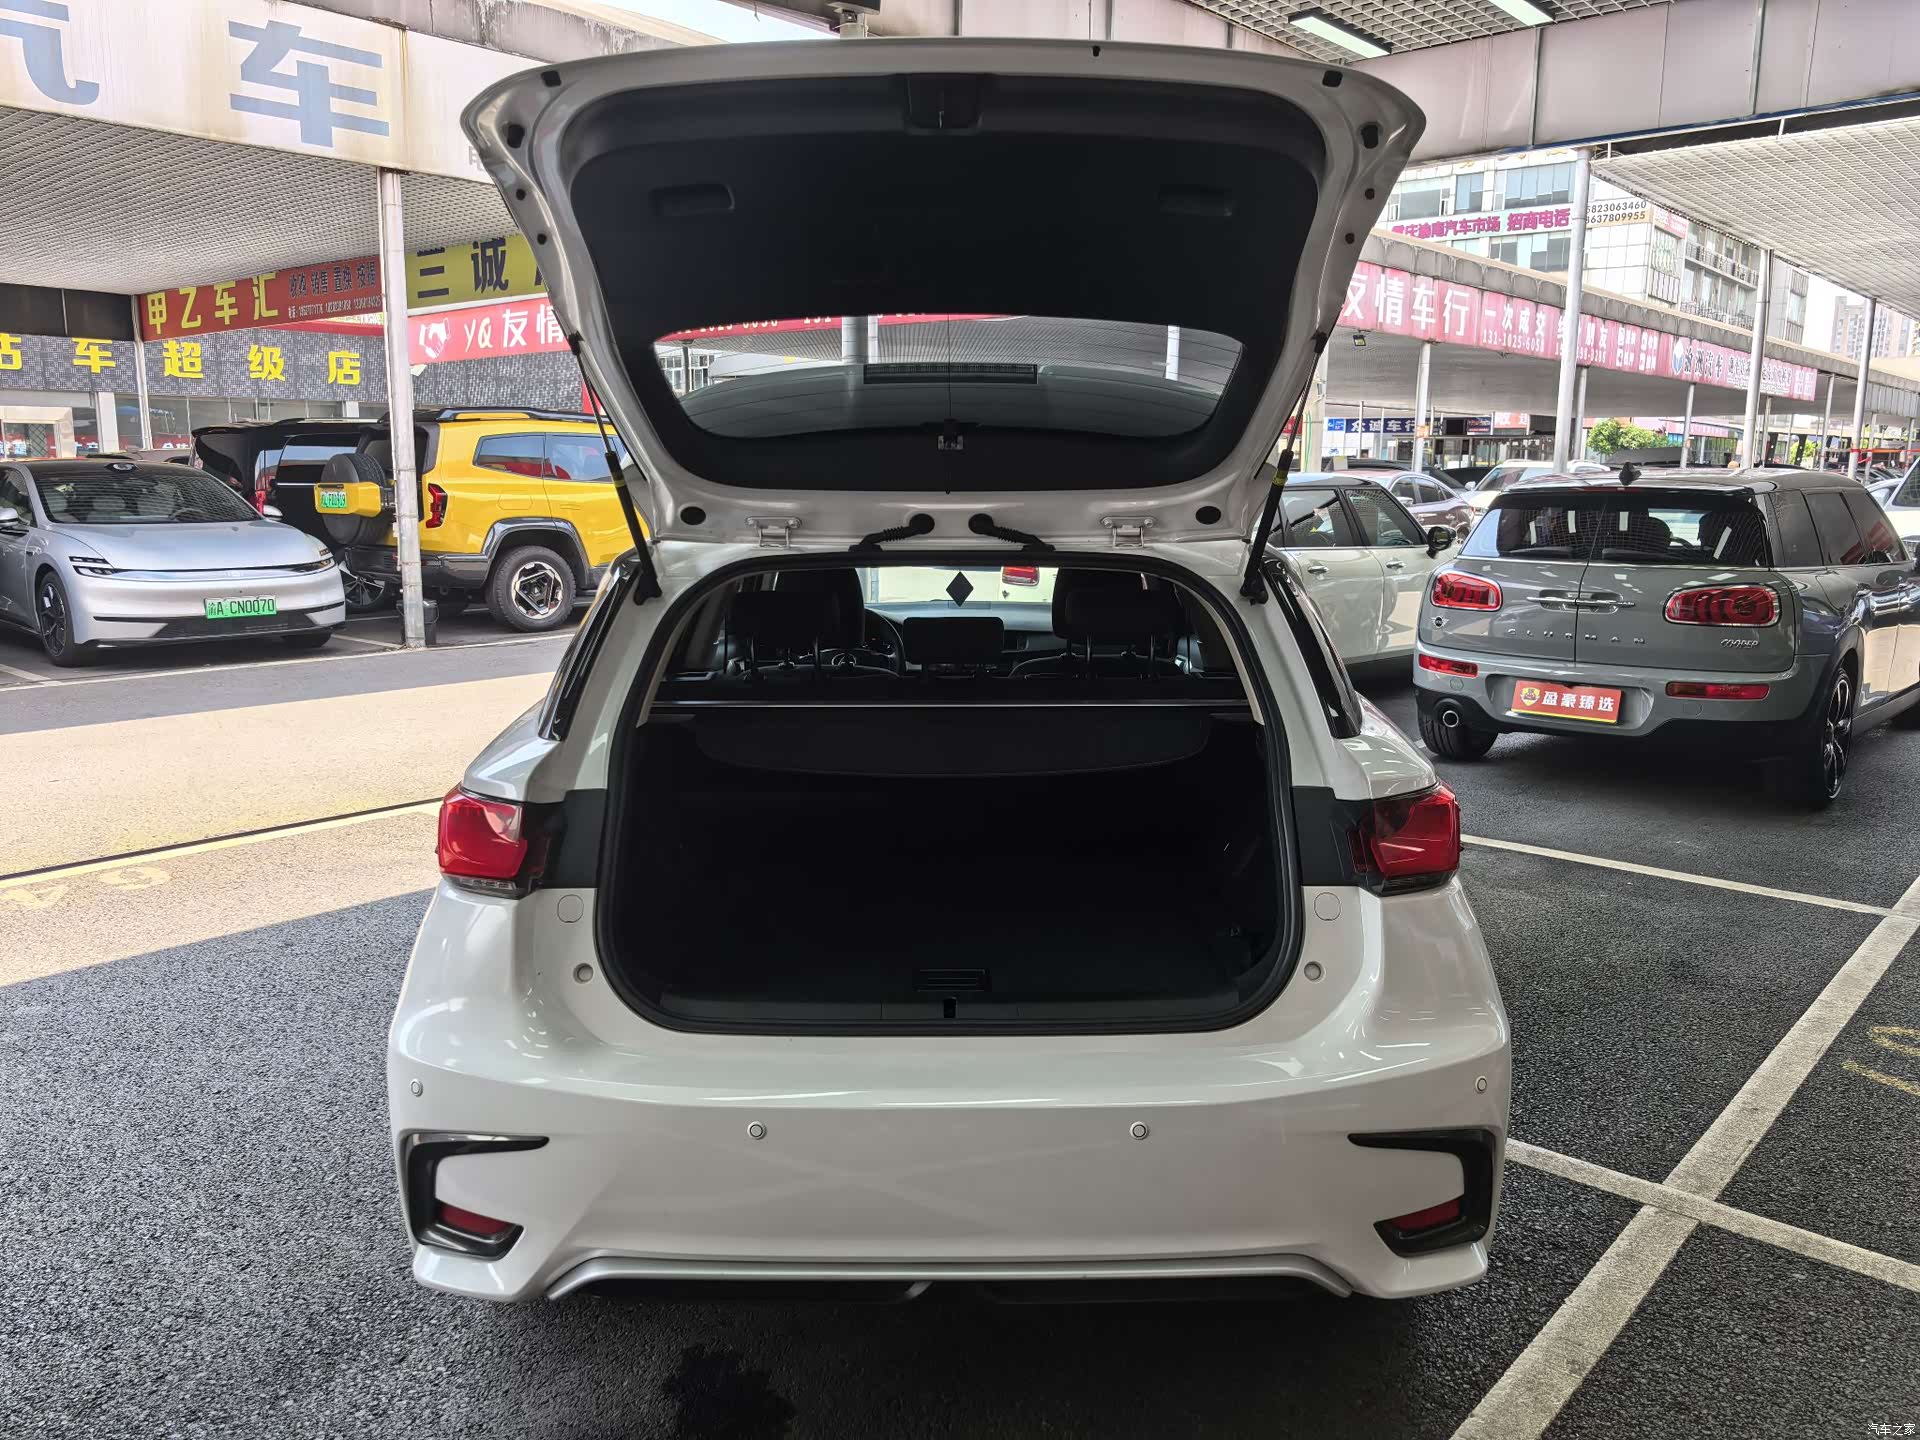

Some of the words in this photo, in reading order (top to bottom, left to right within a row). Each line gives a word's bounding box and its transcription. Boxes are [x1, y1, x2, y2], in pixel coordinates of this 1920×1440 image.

[1507, 208, 1571, 231] 招商电话
[416, 236, 545, 299] 三诚
[146, 272, 279, 336] 甲乙车汇
